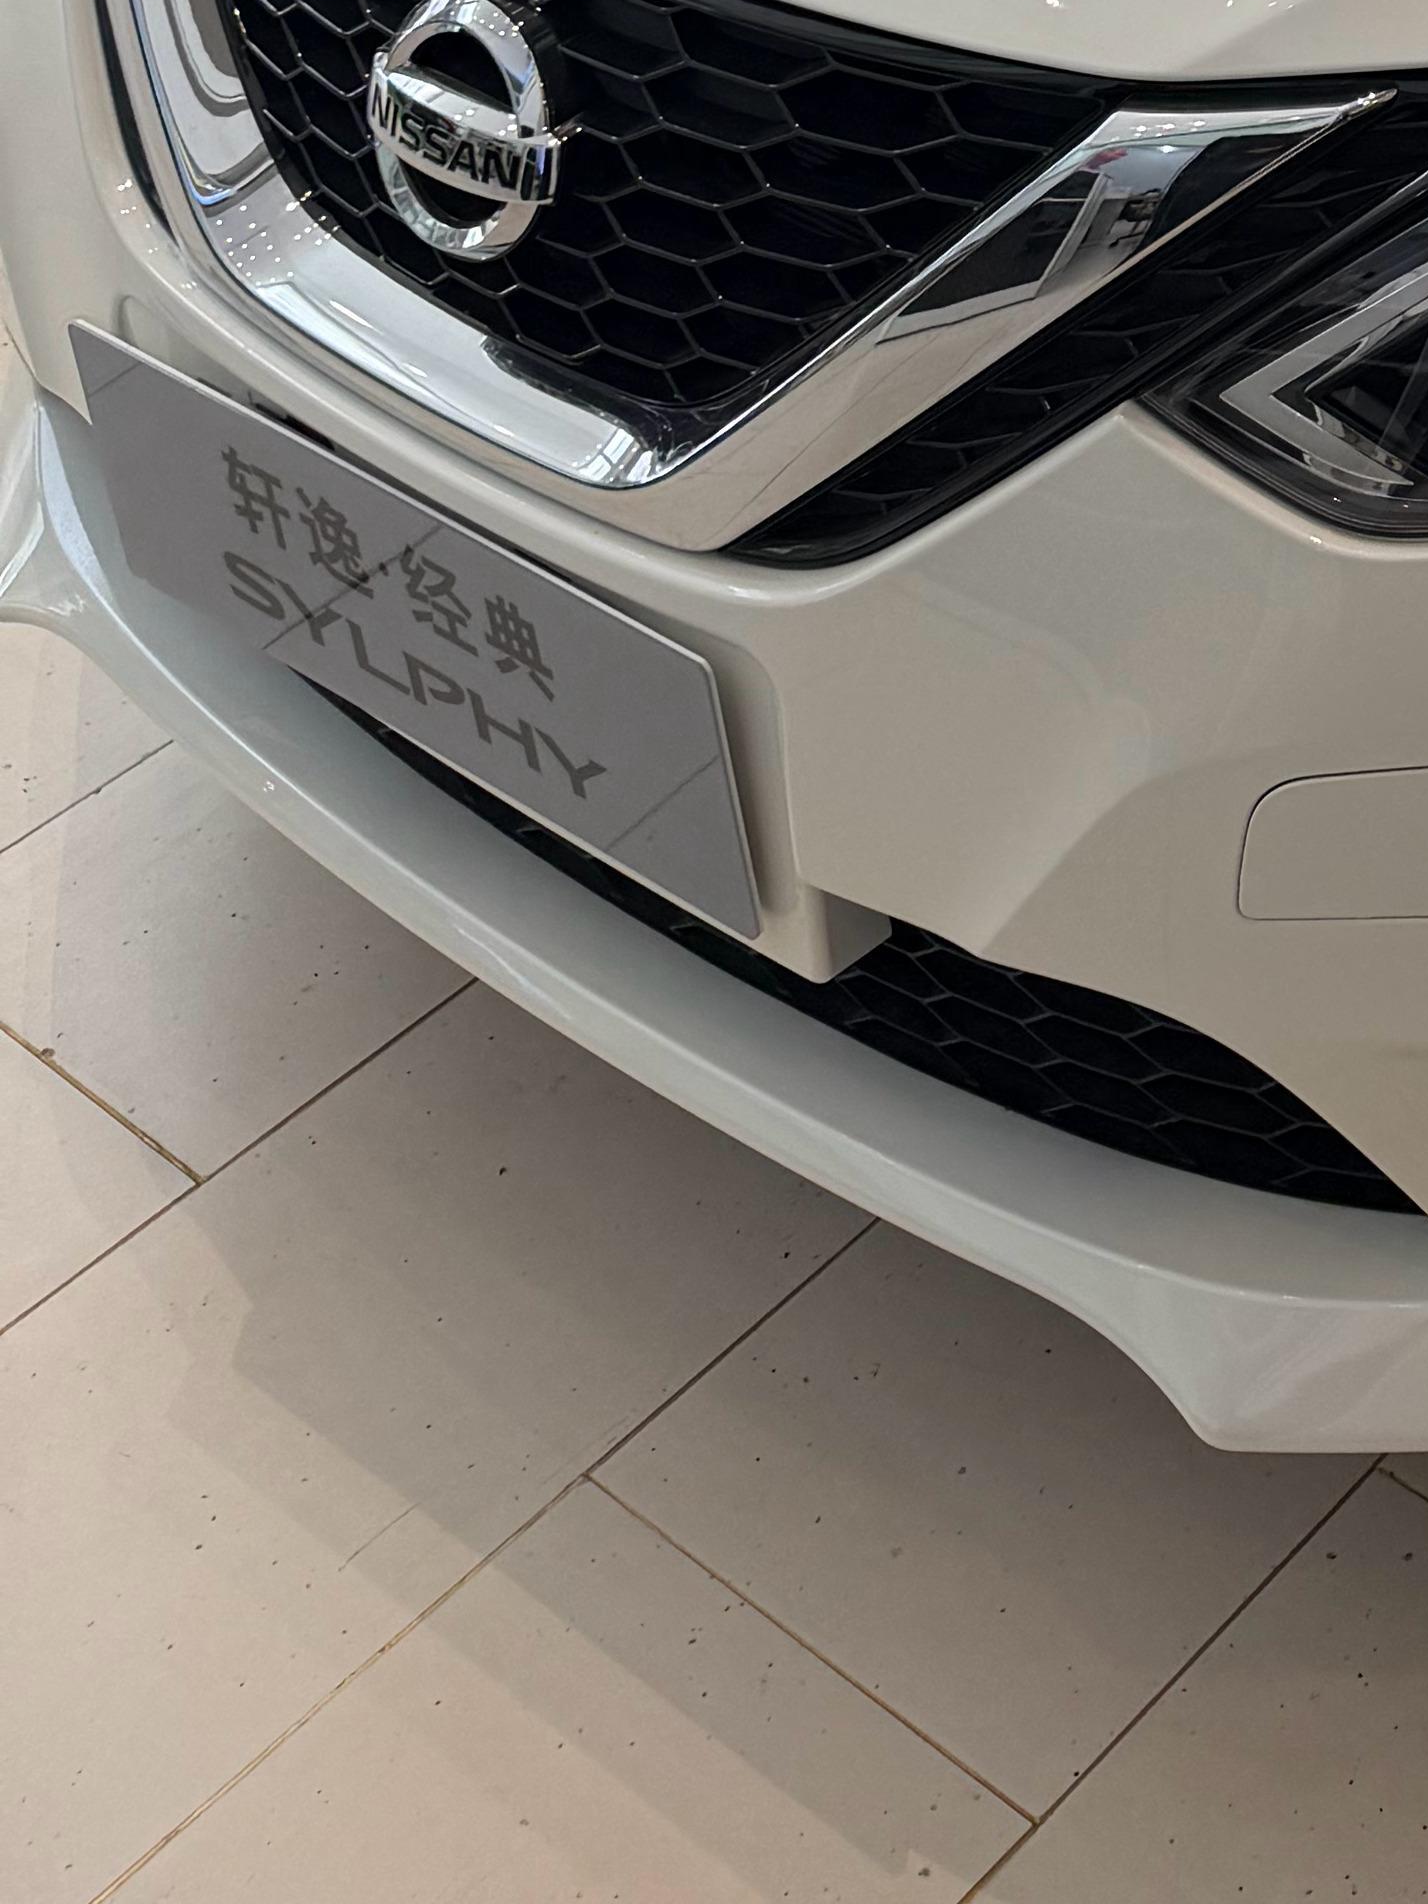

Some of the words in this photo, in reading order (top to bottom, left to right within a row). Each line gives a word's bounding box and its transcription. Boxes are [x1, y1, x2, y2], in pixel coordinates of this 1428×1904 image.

[371, 80, 521, 191] NISSAN
[221, 445, 555, 703] 轩逸·经典
[223, 550, 608, 800] SYLPHY
